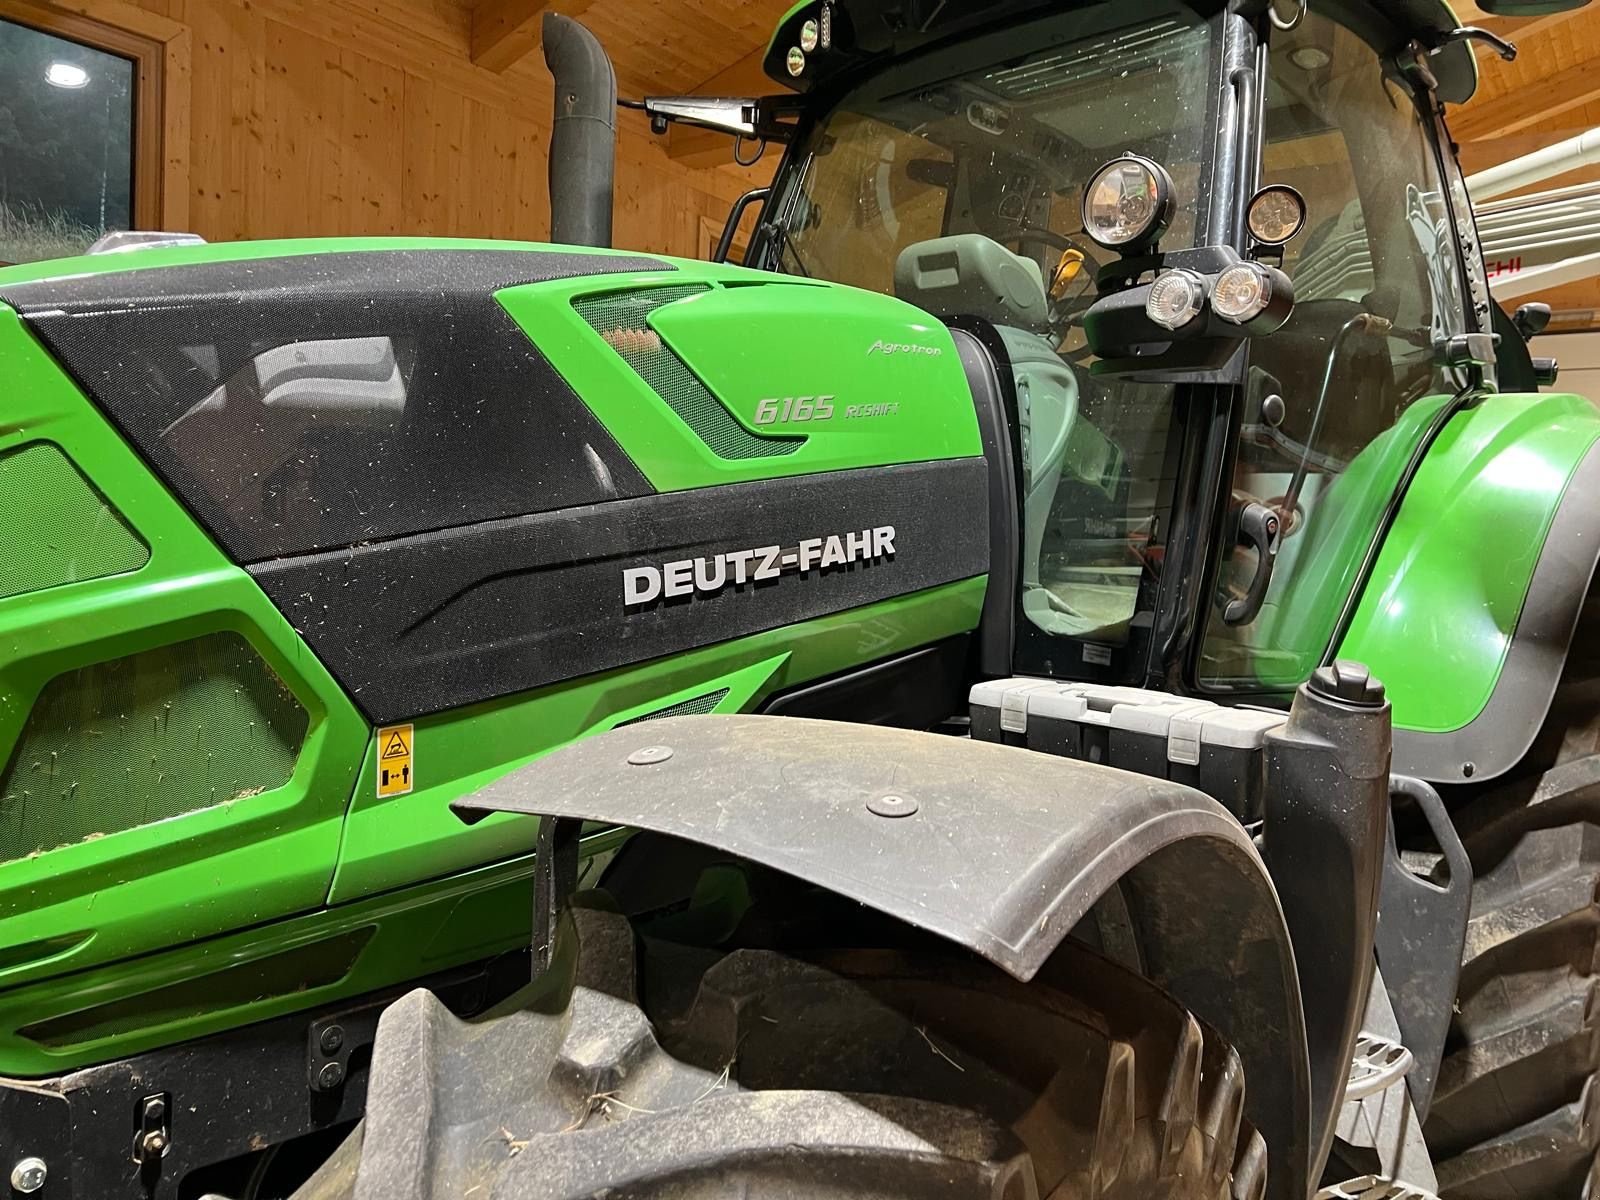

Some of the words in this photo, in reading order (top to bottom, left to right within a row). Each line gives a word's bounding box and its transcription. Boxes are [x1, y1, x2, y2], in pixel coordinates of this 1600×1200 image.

[867, 339, 942, 356] Agrotron
[754, 395, 835, 425] 6165
[623, 525, 896, 606] DEUTZ-FAHR
